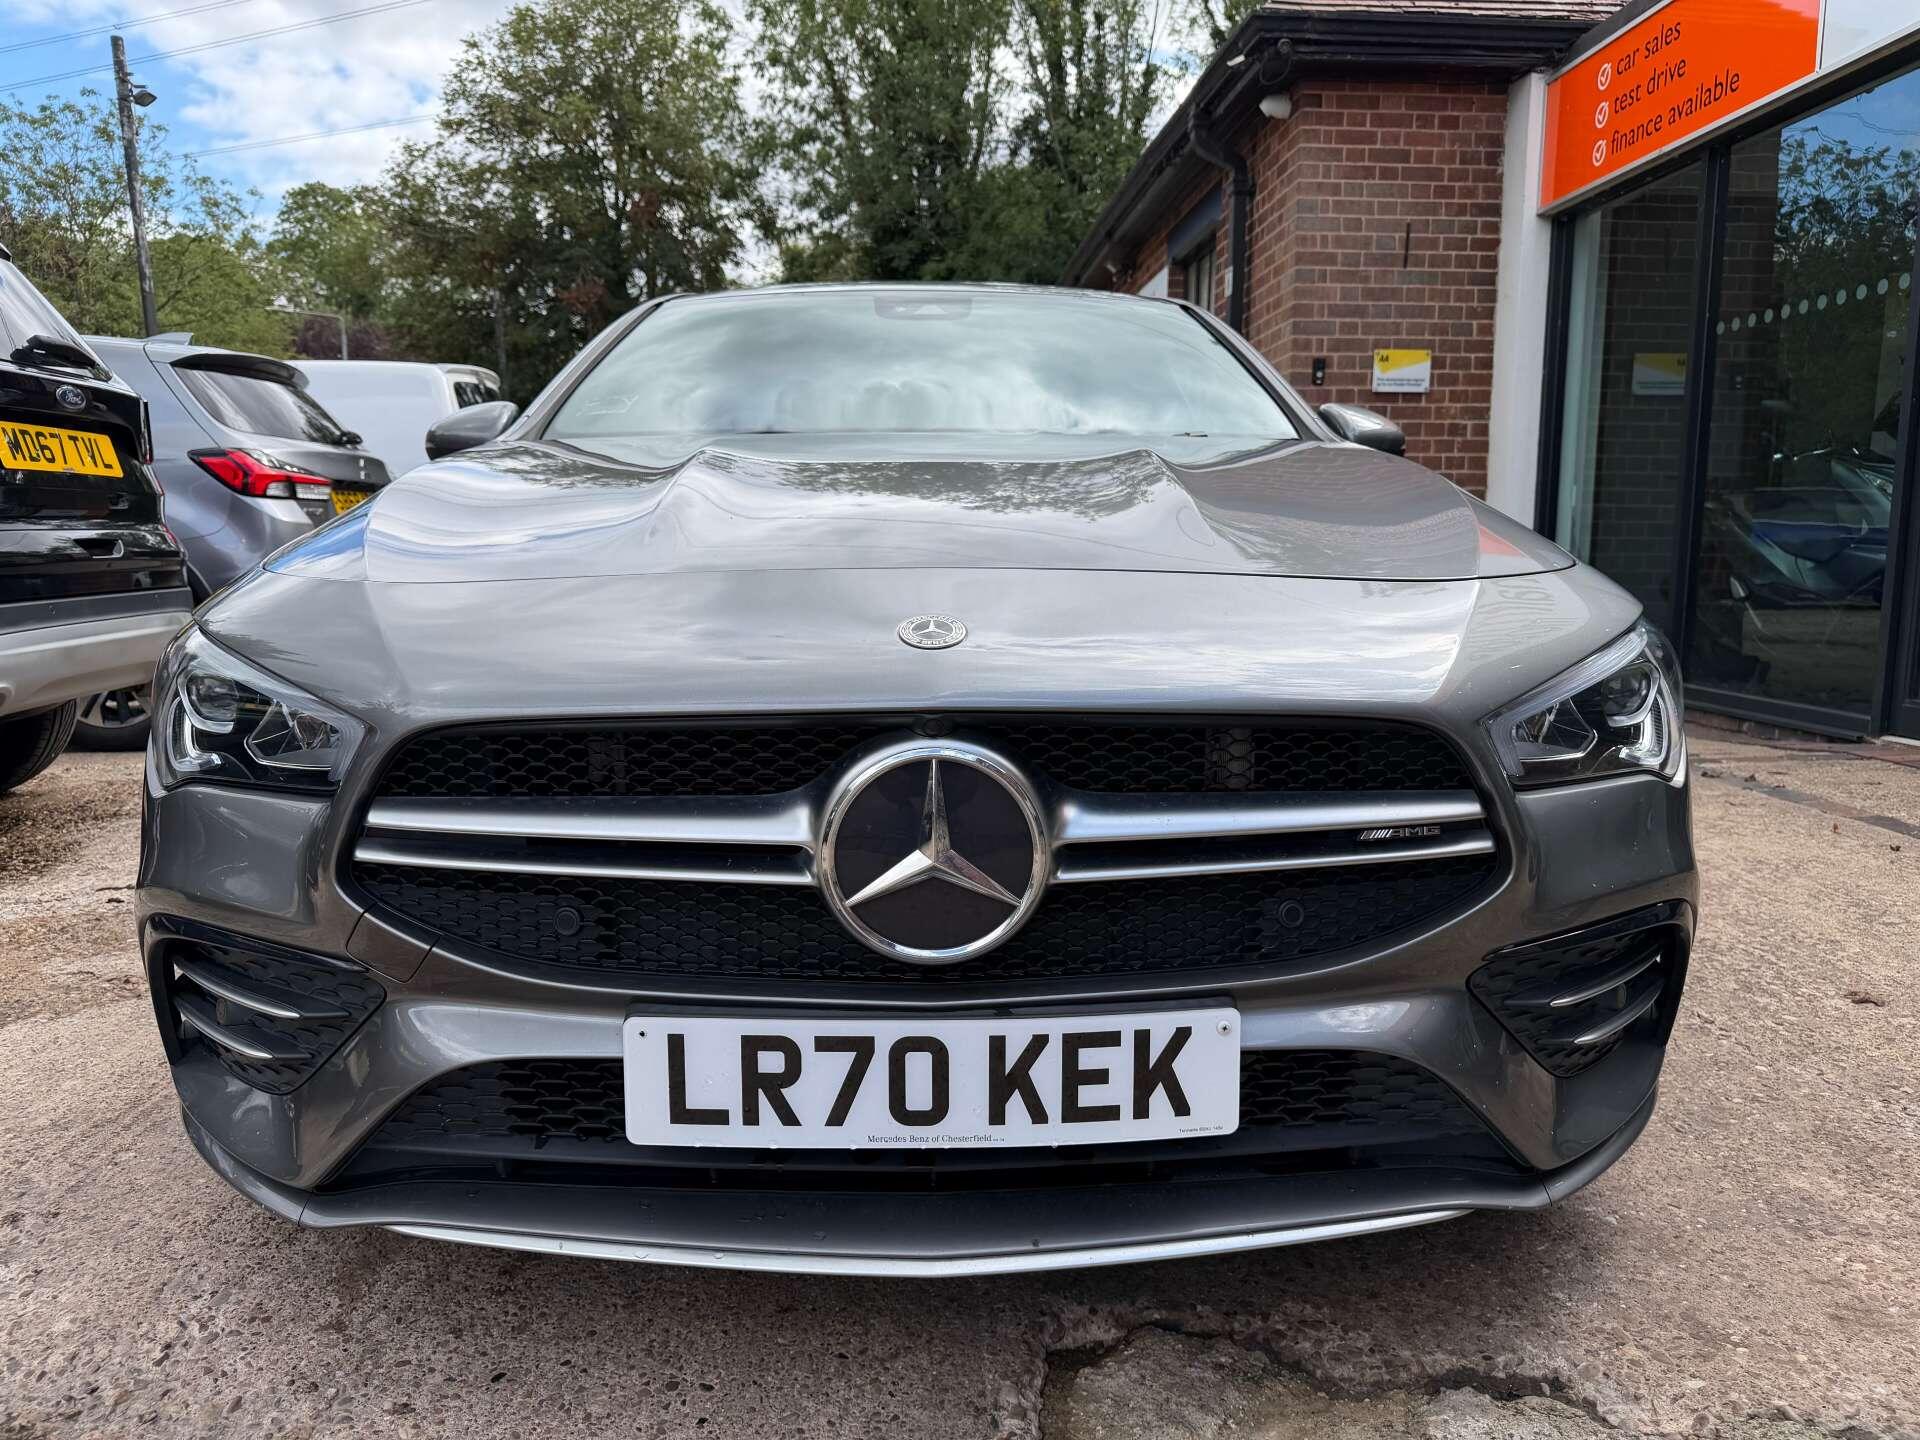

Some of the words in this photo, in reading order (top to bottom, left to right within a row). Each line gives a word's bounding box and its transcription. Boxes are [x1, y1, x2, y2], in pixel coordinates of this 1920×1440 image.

[1616, 48, 1640, 76] car
[1644, 22, 1681, 60] sales
[1611, 113, 1663, 155] finance
[1668, 68, 1740, 126] available
[1614, 84, 1642, 114] test
[1646, 58, 1686, 96] drive
[1, 426, 68, 466] MD67
[68, 434, 114, 470] TVL
[667, 1033, 950, 1126] LR70
[988, 1025, 1193, 1126] KEK
[941, 1133, 992, 1143] Chesterfield
